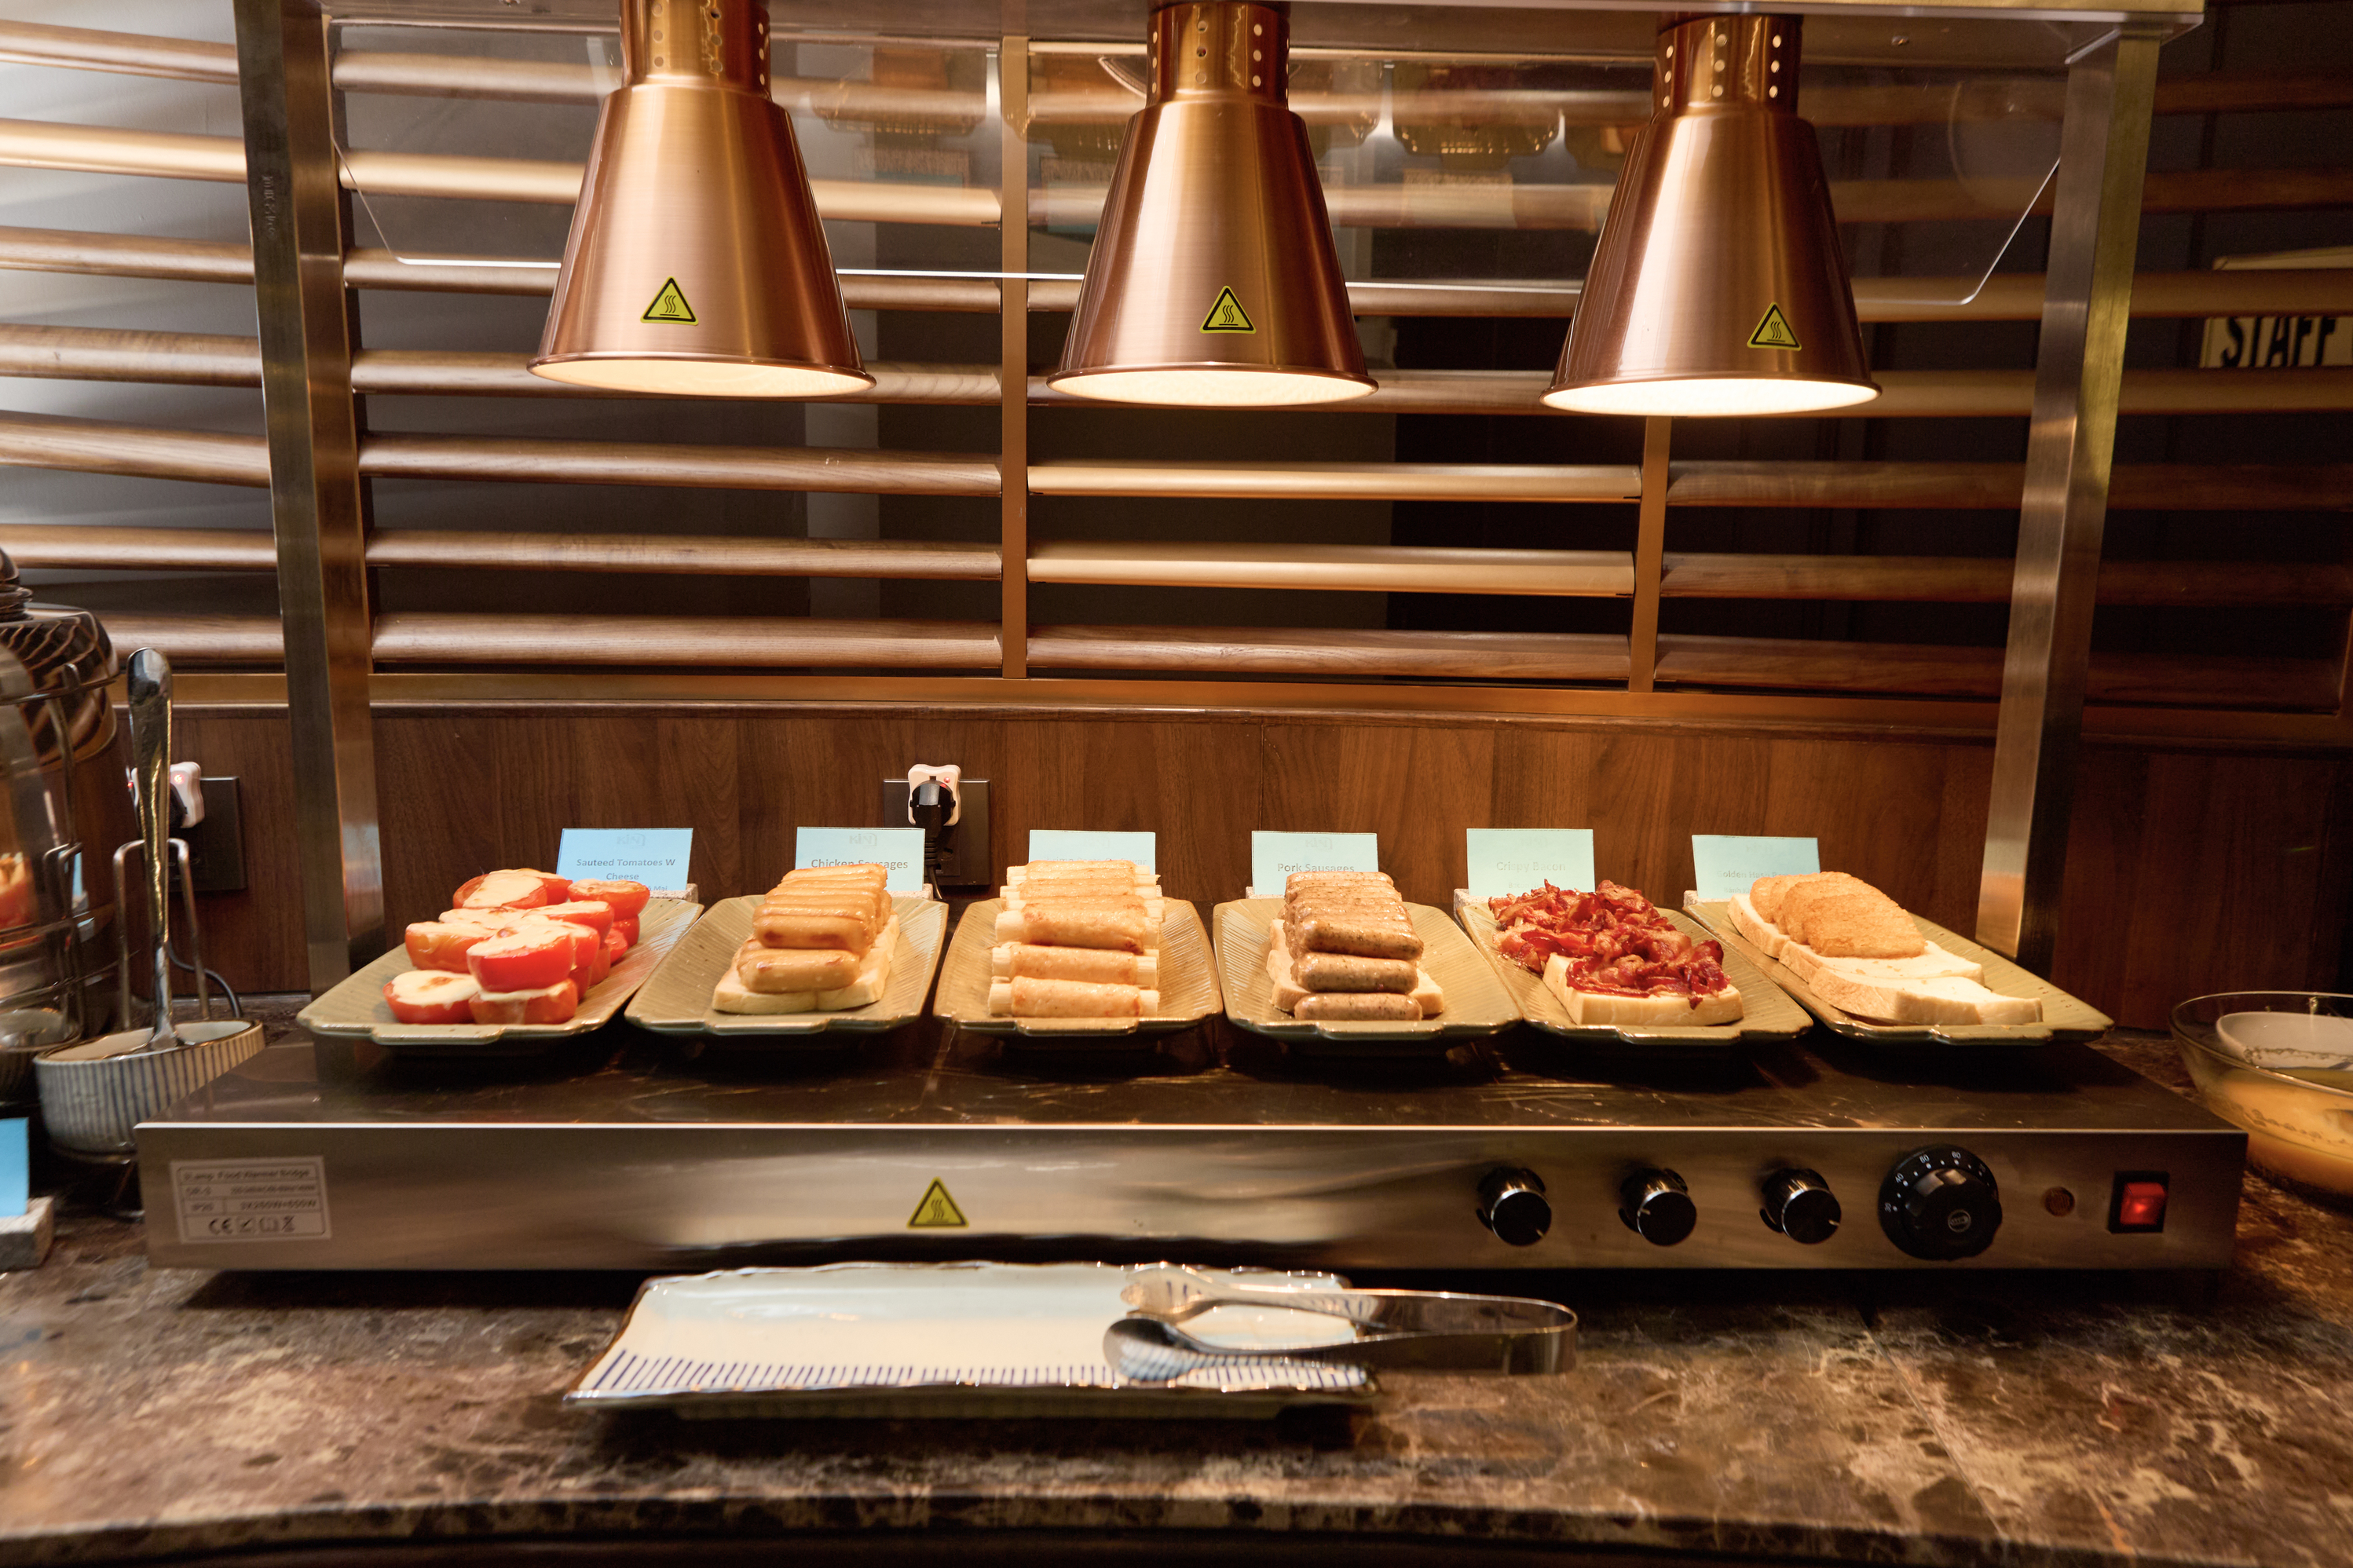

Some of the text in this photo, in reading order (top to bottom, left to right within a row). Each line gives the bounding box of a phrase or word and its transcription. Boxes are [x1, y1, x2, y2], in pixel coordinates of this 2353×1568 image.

[576, 858, 675, 867] Sauteed Tomatoes W
[1277, 863, 1355, 872] Pork Sausages
[1497, 861, 1566, 873] Crispy Bacon
[1919, 1154, 1930, 1164] 50
[1895, 1172, 1905, 1183] 40
